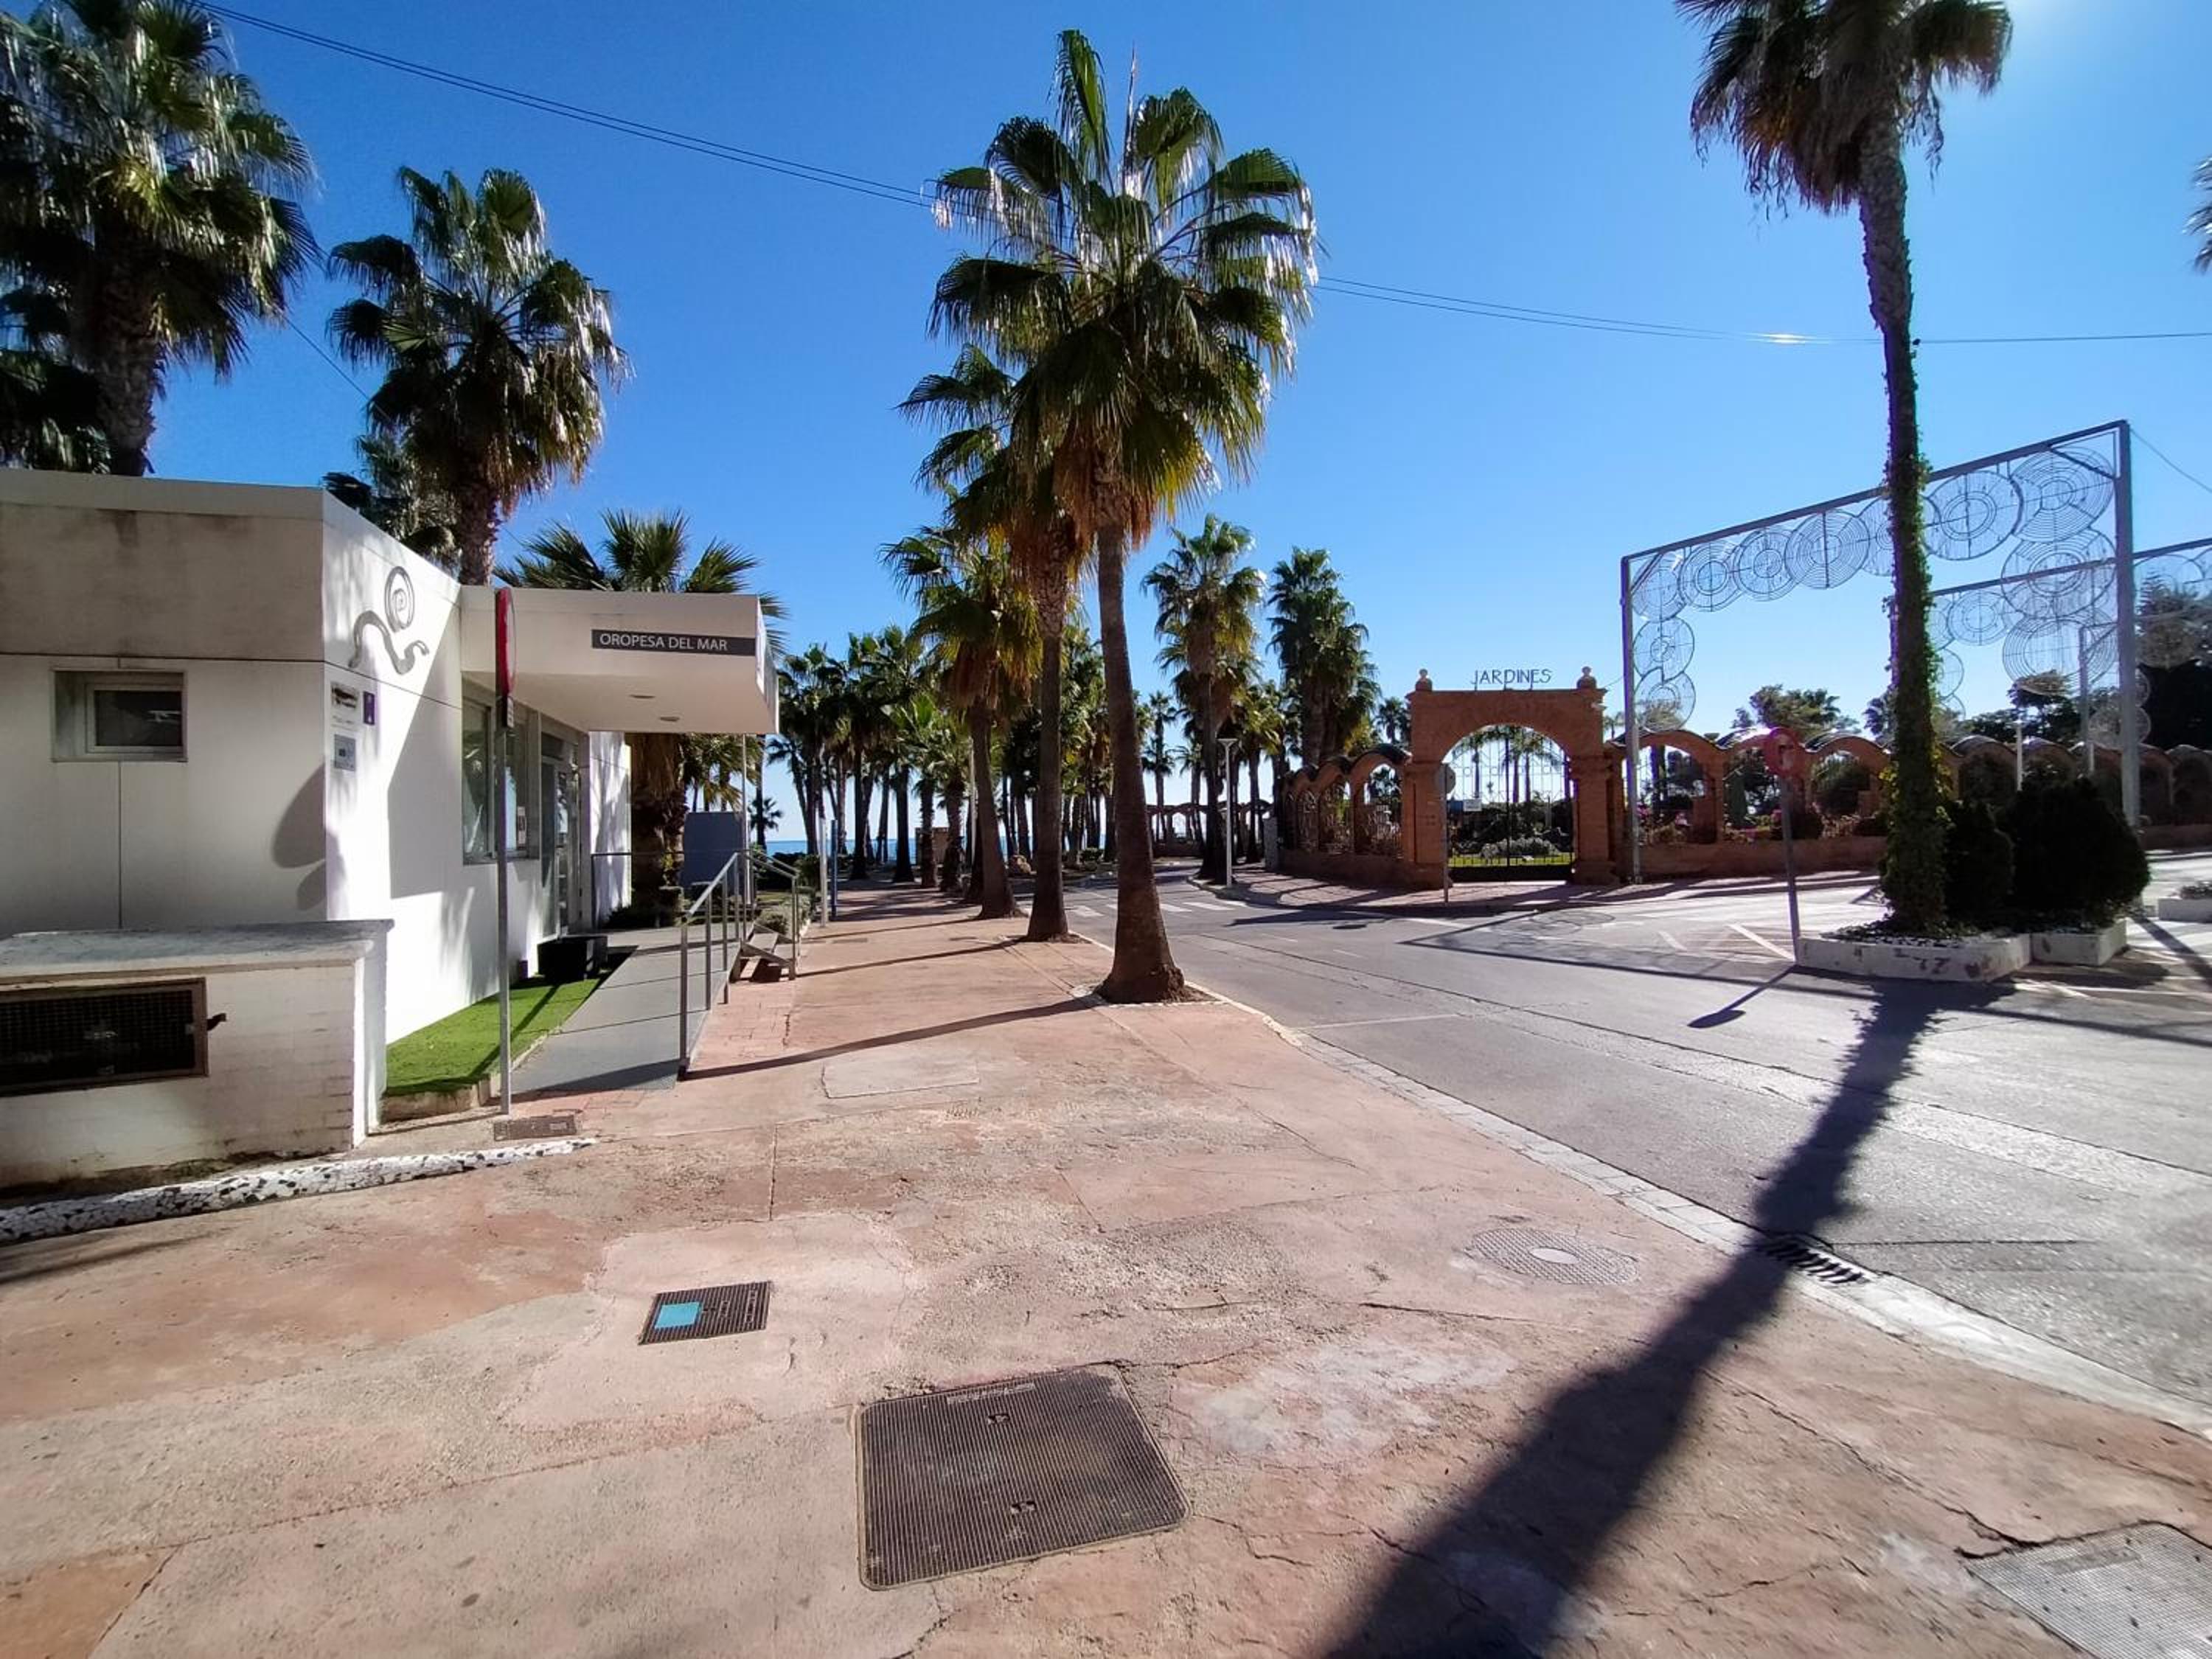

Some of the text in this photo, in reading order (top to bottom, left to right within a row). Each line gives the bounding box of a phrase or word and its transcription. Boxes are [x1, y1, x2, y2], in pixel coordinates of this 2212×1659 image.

[599, 633, 728, 651] OROPESA DEL MAR
[1470, 668, 1552, 685] JARDINES
